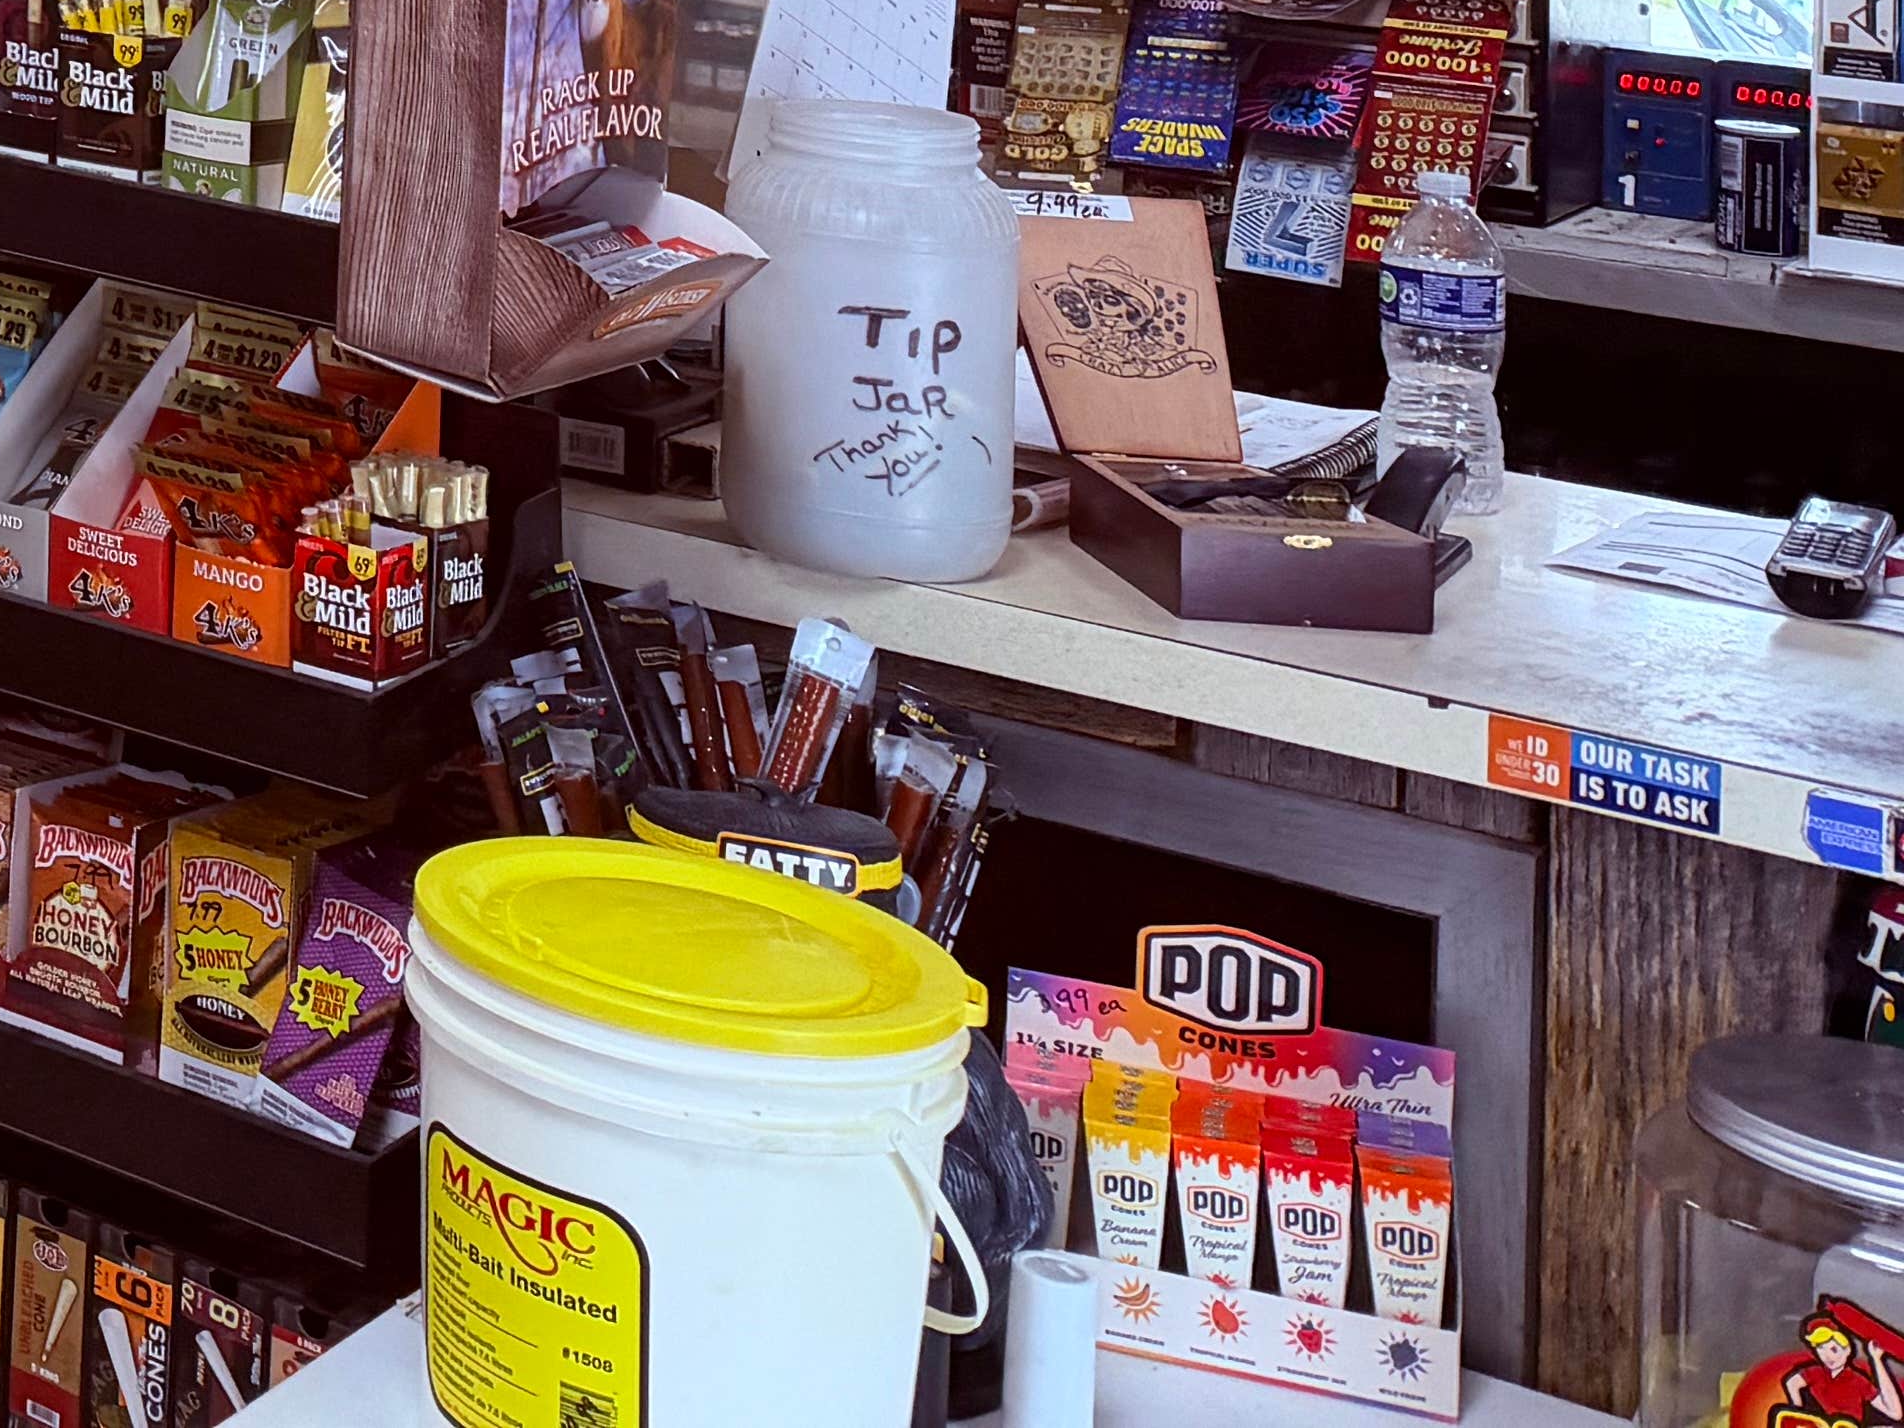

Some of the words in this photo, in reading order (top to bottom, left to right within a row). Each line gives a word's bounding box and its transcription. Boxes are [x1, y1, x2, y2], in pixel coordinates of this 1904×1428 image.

[541, 72, 602, 116] RACK
[607, 68, 634, 99] UP
[513, 124, 576, 175] REAL
[580, 106, 663, 143] FLAVOR
[173, 158, 239, 182] NATURAL
[193, 559, 264, 593] MANGO
[304, 575, 372, 610] Black
[315, 607, 372, 636] Mild
[1580, 741, 1634, 775] OUR
[1641, 753, 1711, 792] TASK
[1579, 773, 1605, 801] IS
[1612, 782, 1648, 810] TO
[1654, 791, 1710, 826] ASK
[180, 856, 284, 928] BACKWOODS
[1158, 943, 1301, 1025] POP
[1178, 1025, 1276, 1062] CONES
[439, 1144, 597, 1255] MAGIC
[432, 1210, 505, 1287] Multi-Bait
[509, 1269, 618, 1326] Insulated
[561, 1344, 614, 1375] #1508
